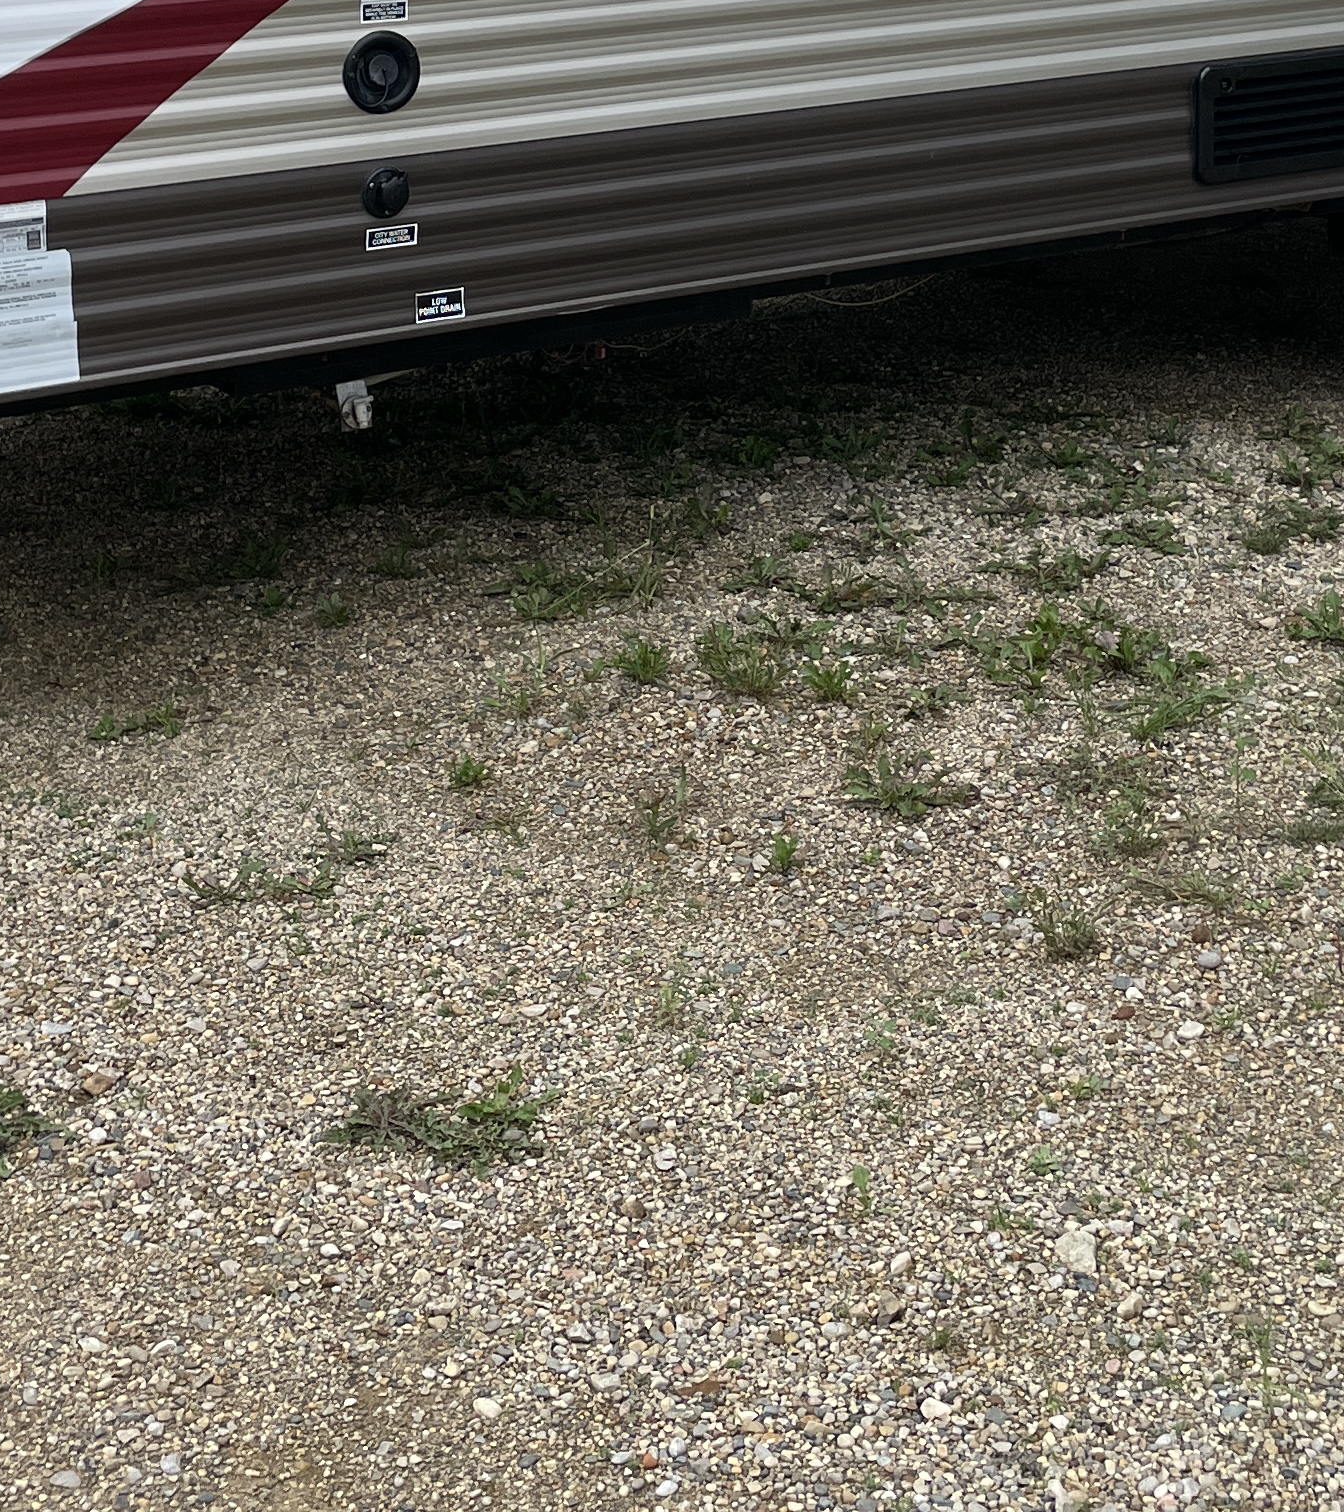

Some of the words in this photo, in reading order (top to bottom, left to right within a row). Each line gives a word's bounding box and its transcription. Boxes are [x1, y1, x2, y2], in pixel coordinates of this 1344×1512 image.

[372, 235, 411, 245] CONNECTION
[431, 297, 447, 306] LOW
[419, 306, 439, 316] POINT
[440, 303, 461, 313] DRAIN
